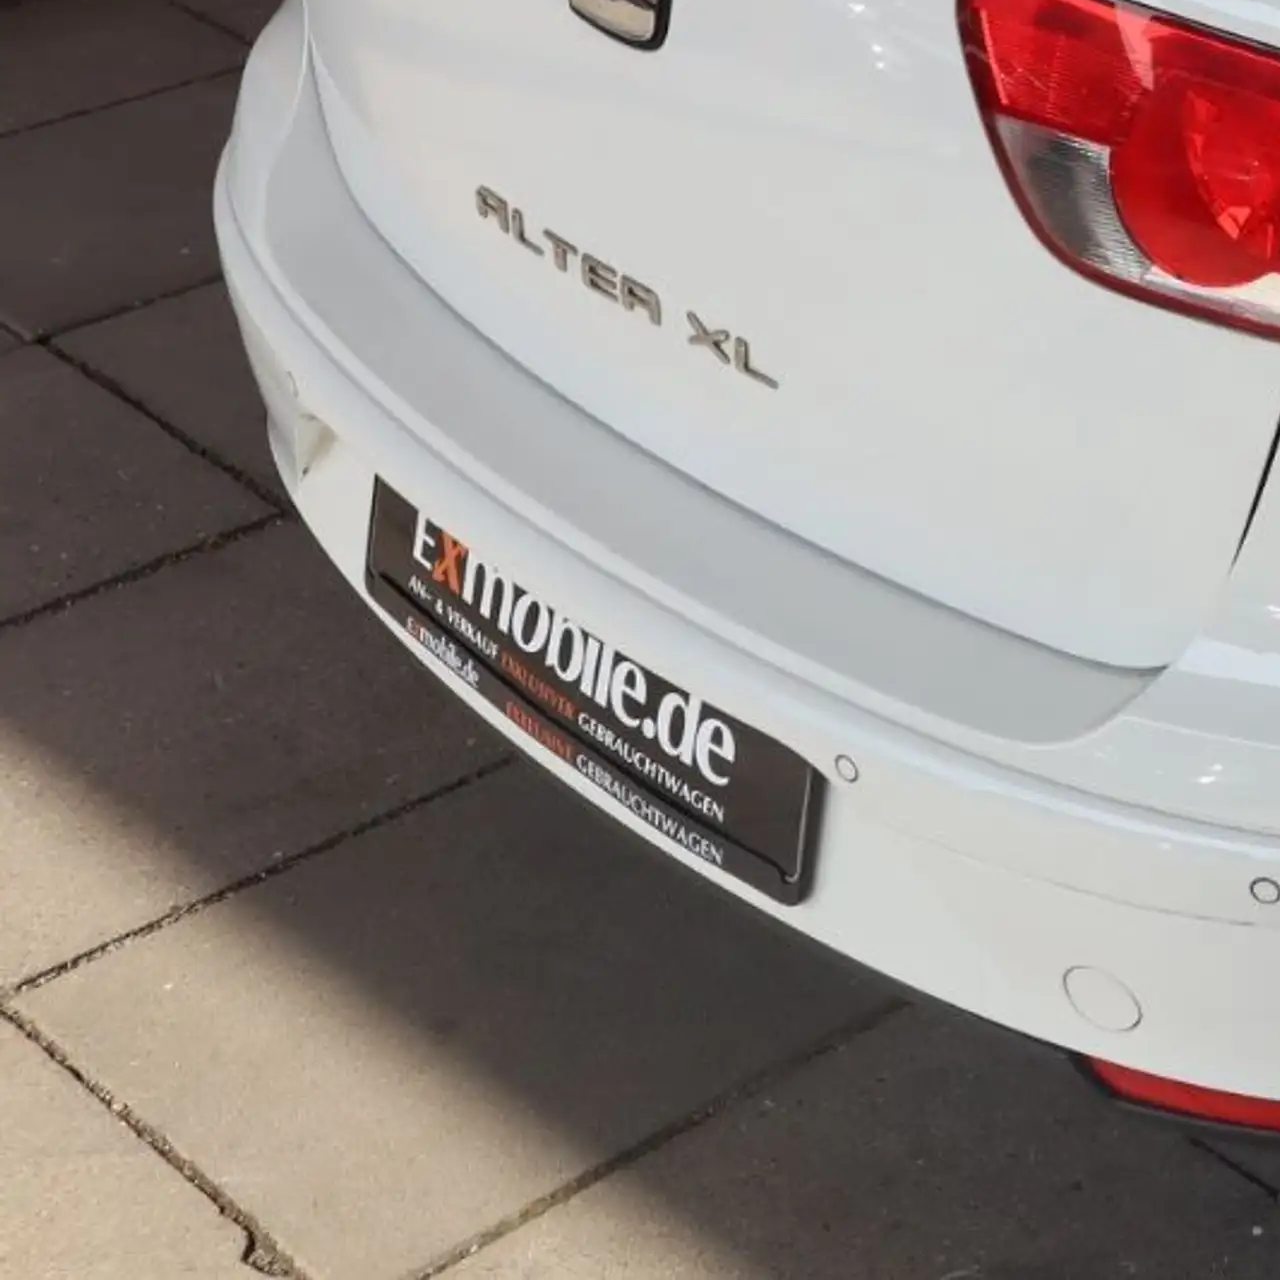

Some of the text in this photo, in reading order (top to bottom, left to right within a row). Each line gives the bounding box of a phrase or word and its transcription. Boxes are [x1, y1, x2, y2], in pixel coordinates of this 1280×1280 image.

[474, 184, 780, 391] ALTEA XL
[575, 752, 724, 865] GEBRAUCHTWAGEN
[577, 711, 725, 823] GEBRAUCHTWAGEN
